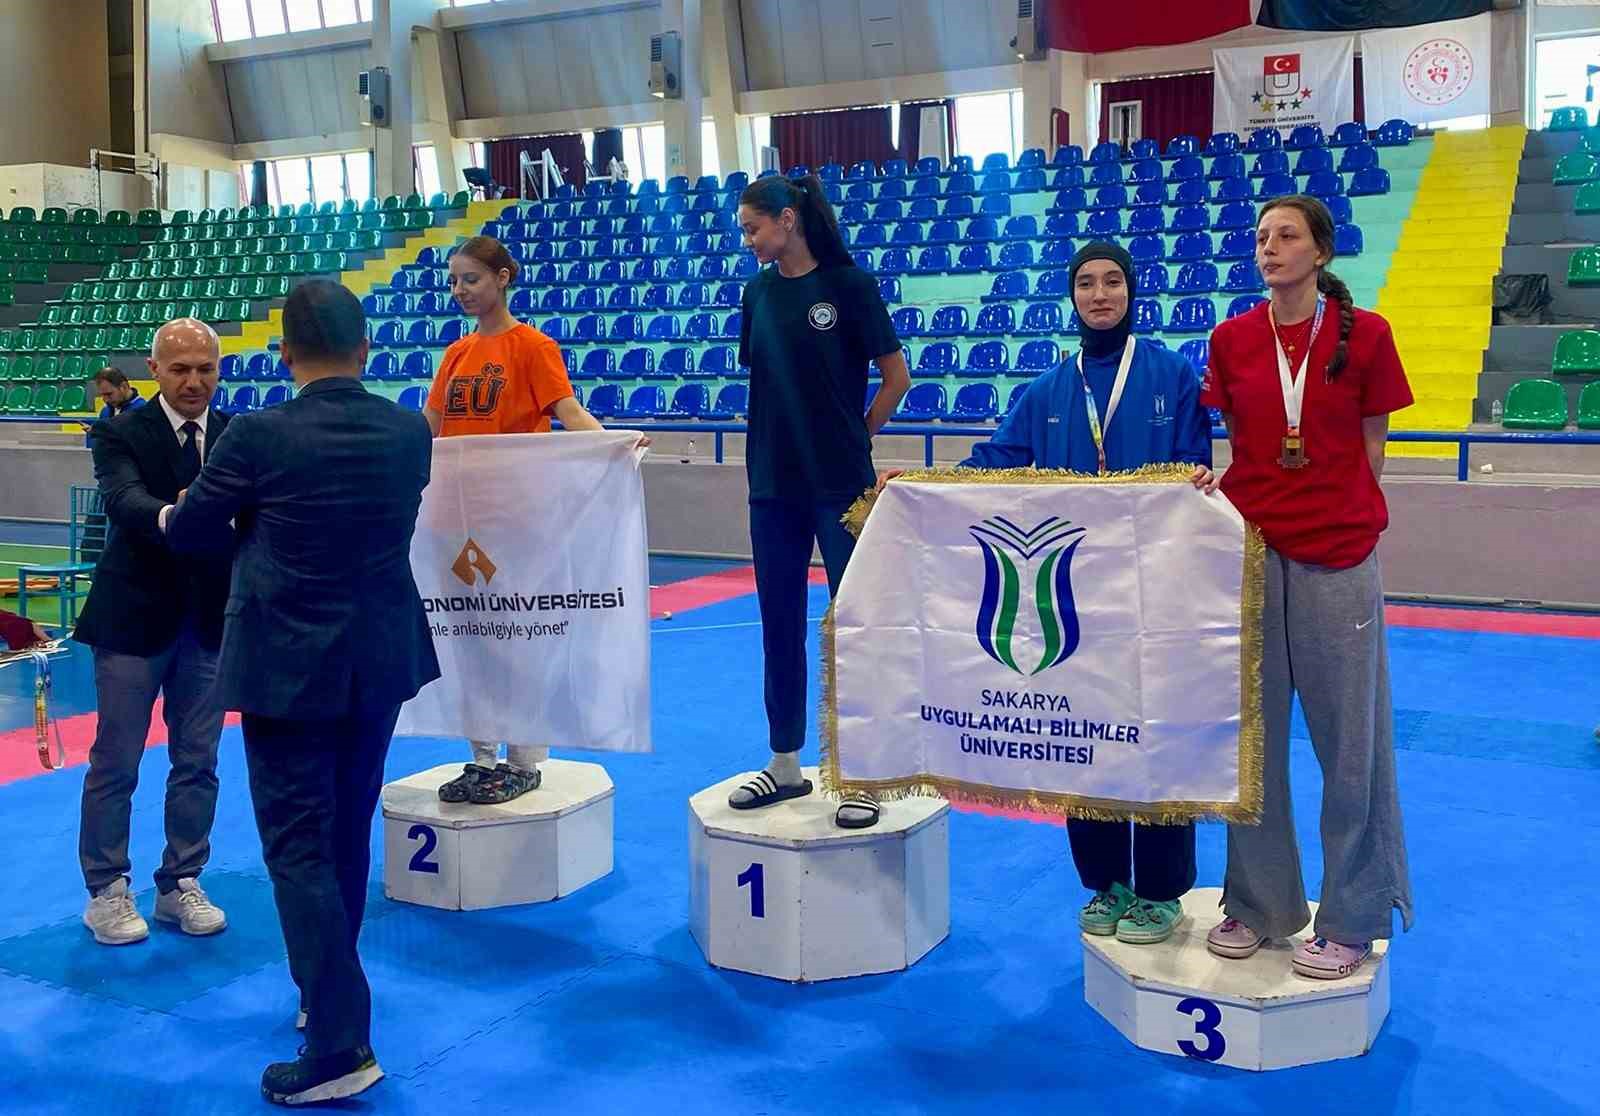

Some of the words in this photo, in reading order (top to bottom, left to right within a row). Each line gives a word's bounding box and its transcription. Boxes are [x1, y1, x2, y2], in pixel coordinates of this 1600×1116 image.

[445, 362, 506, 416] EÜ
[489, 587, 625, 613] ÜNİVERSİTESİ
[981, 689, 1071, 713] SAKARYA
[921, 705, 1042, 735] UYGULAMALI
[1050, 718, 1140, 744] BİLİMLER
[960, 733, 1094, 766] ÜNİVERSİTESİ
[407, 824, 440, 874] 2
[737, 862, 765, 918] 1
[1176, 997, 1226, 1062] 3
